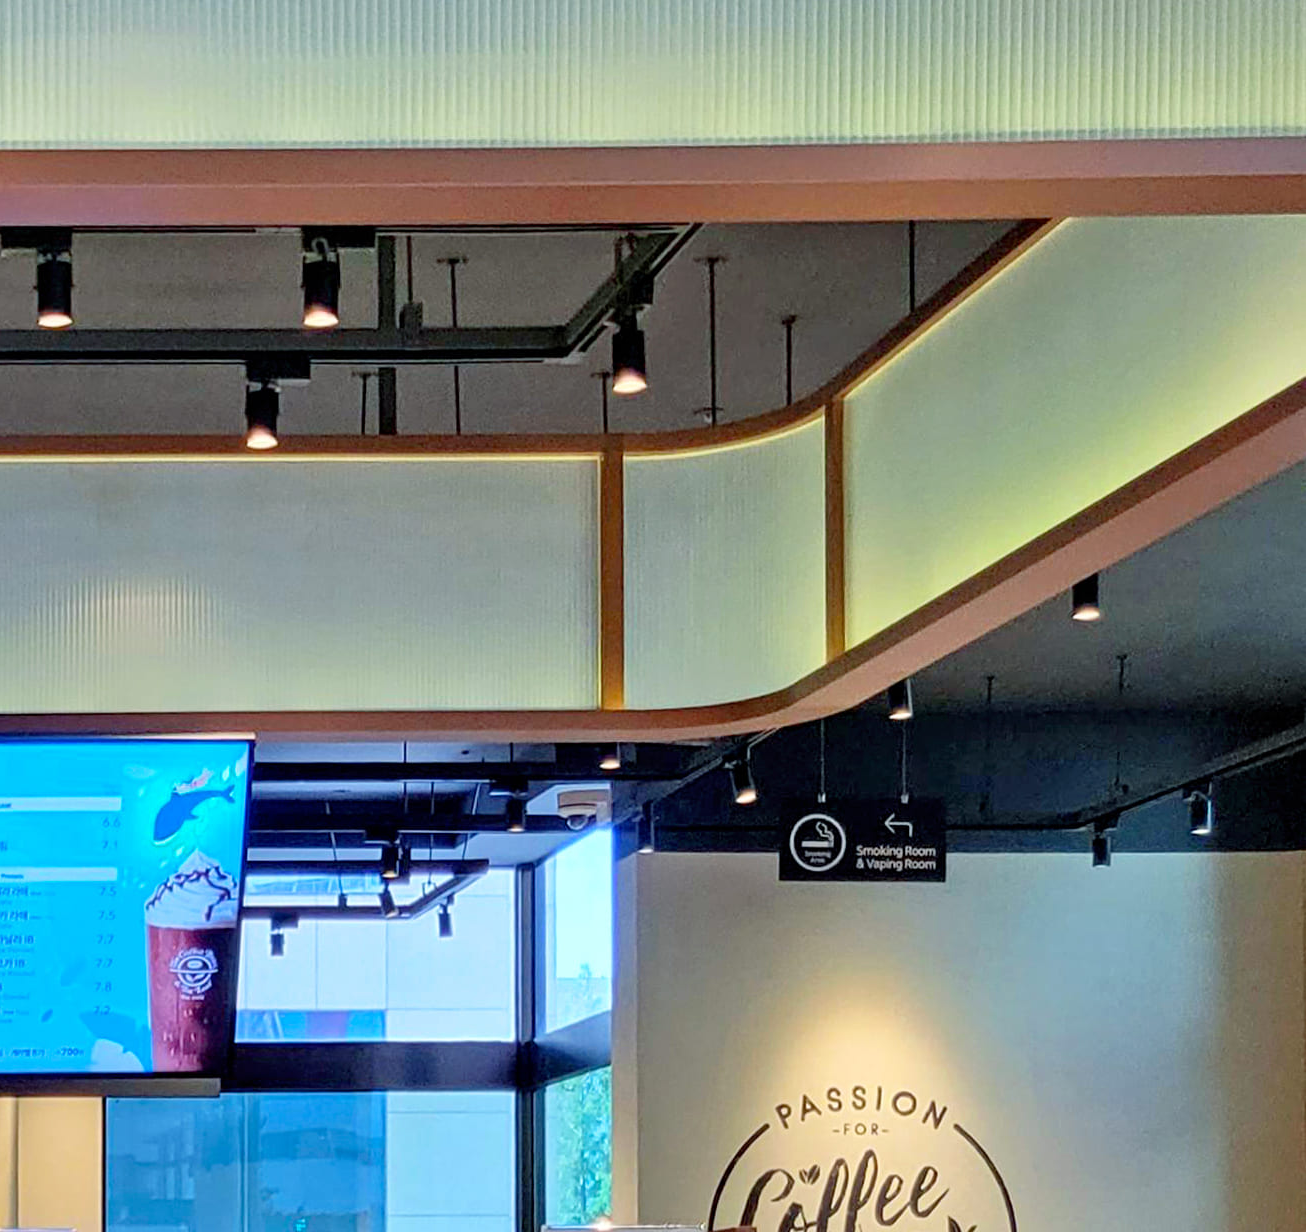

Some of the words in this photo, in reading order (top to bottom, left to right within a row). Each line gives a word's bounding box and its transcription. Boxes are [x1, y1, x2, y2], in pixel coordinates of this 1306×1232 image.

[855, 844, 904, 859] Smoking
[905, 845, 937, 857] Room
[855, 858, 865, 870] &
[866, 858, 903, 872] Vaping
[904, 858, 937, 870] Room
[775, 1085, 948, 1130] PASSION
